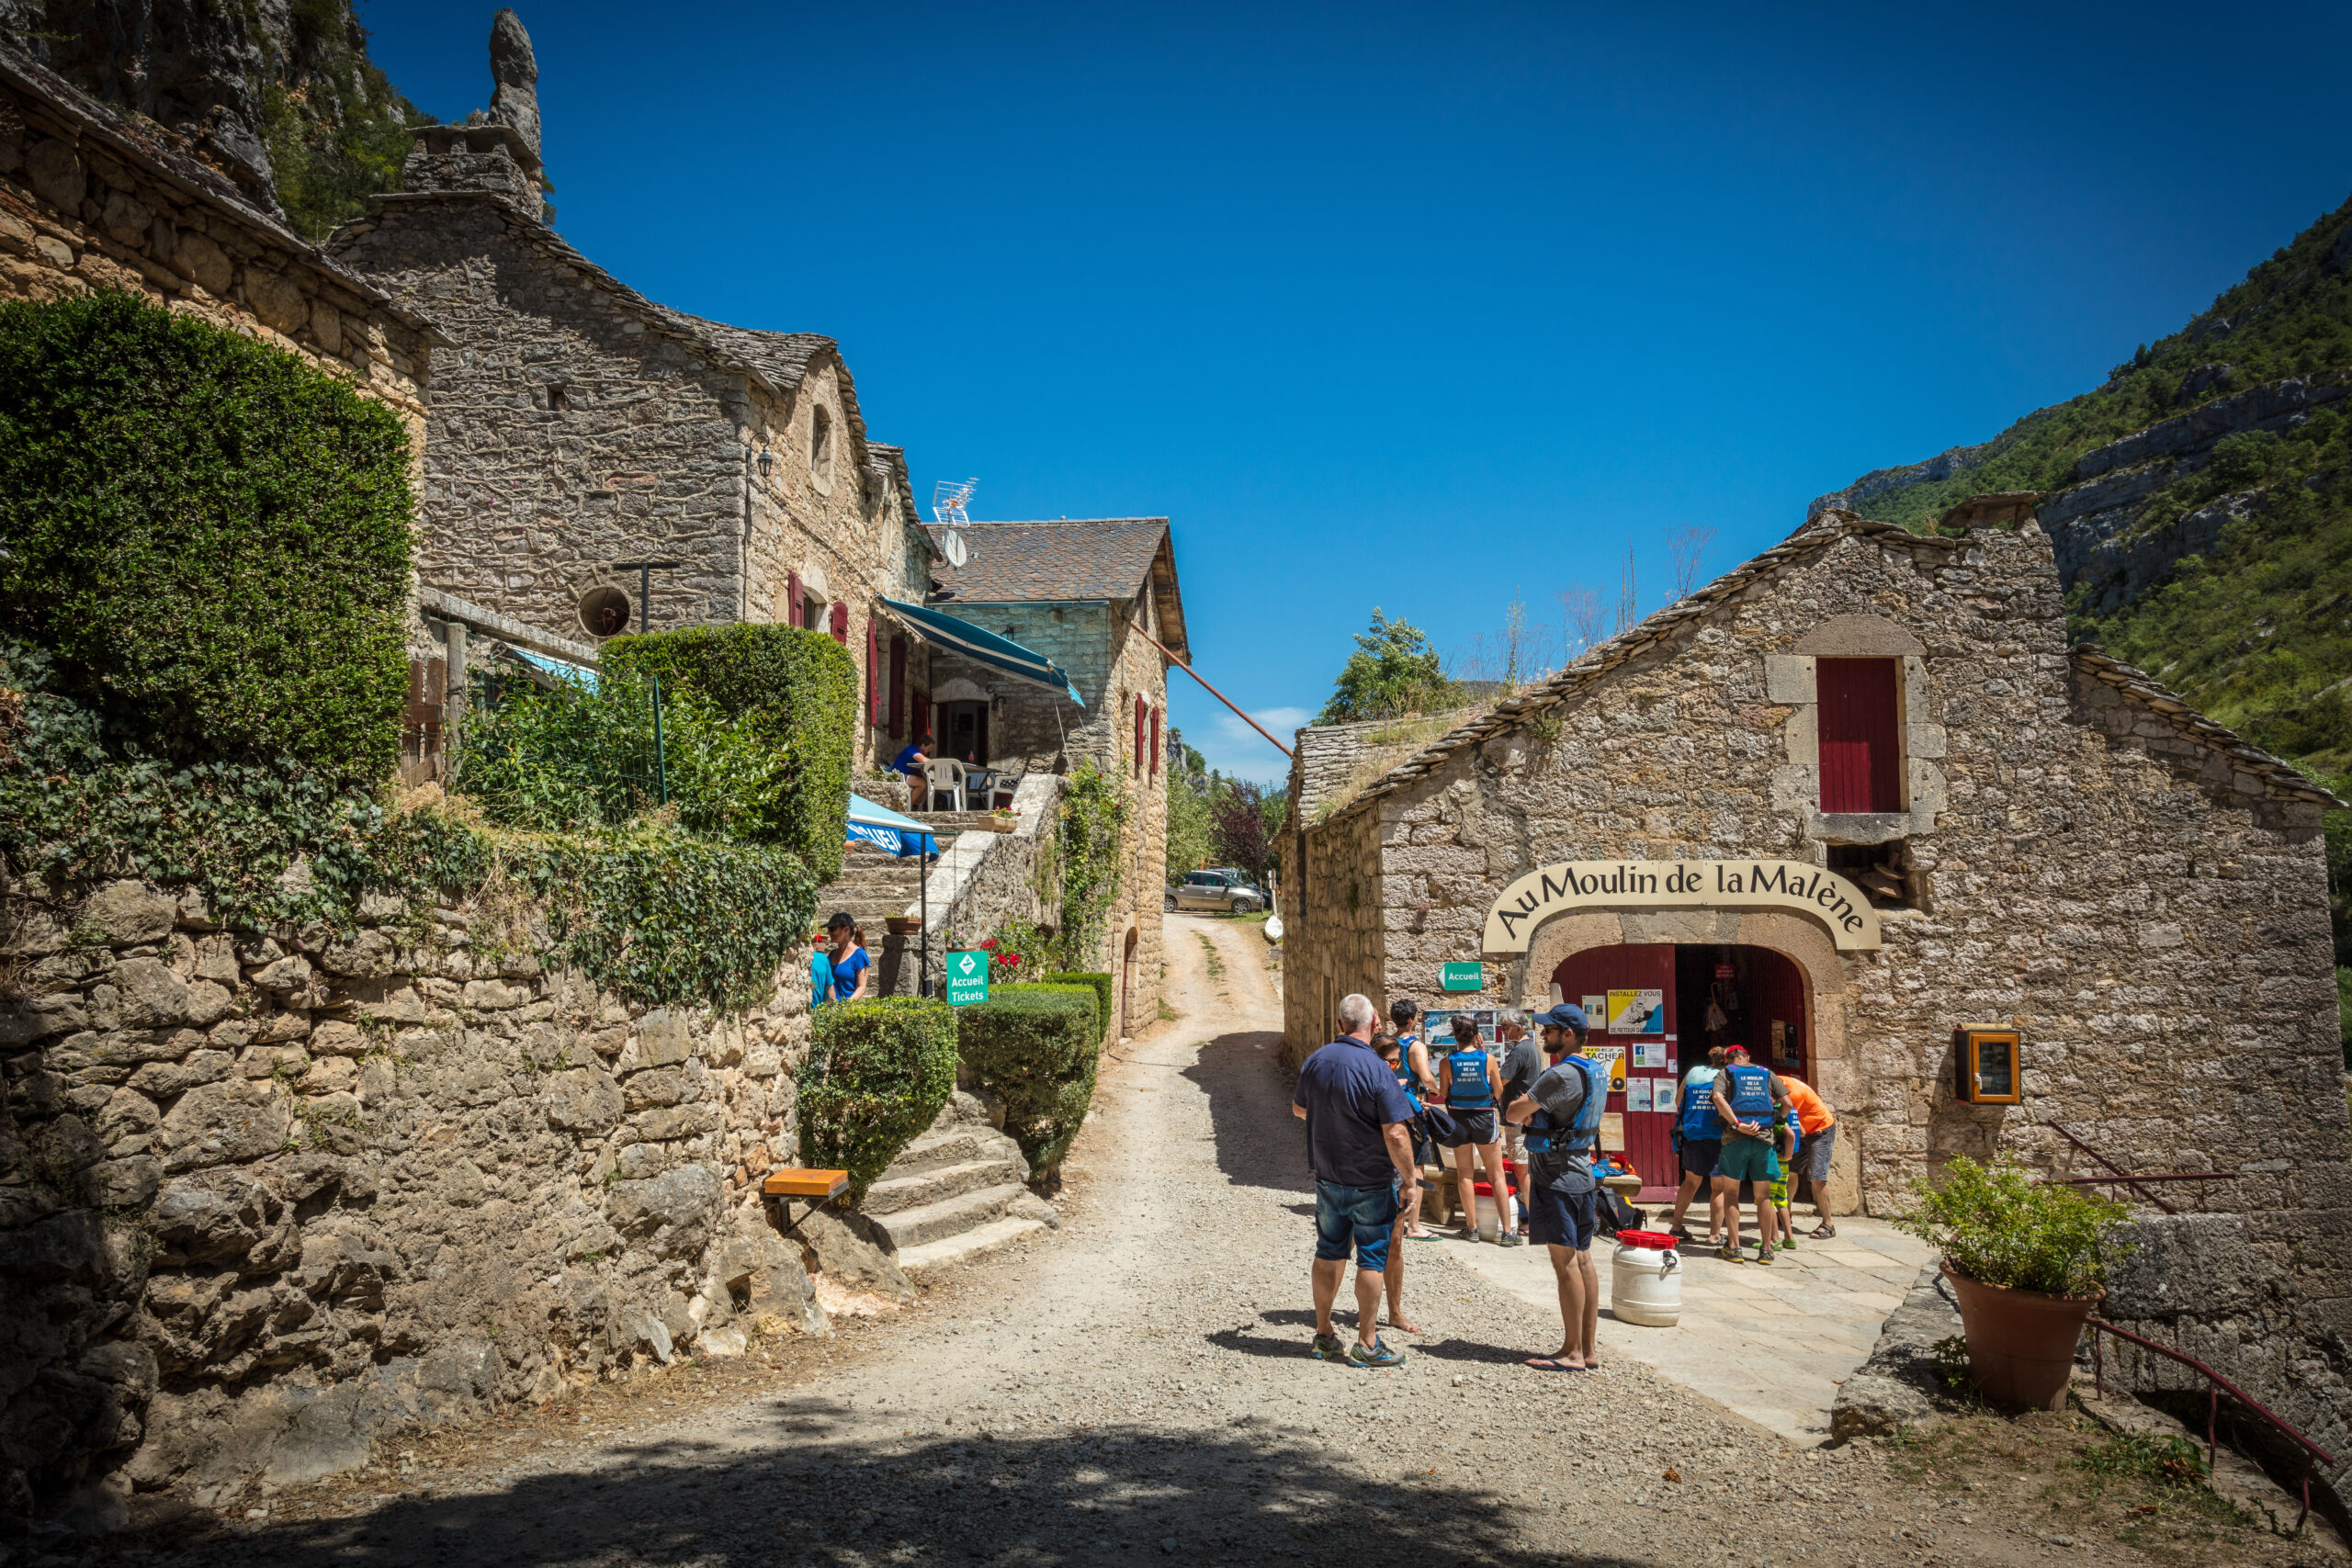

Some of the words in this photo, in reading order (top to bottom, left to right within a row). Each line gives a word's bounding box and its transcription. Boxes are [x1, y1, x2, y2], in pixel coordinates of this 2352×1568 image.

[1498, 889, 1541, 942] Au
[1541, 866, 1657, 903] Moulin
[1666, 864, 1703, 894] de
[1715, 864, 1744, 894] la
[1750, 864, 1863, 934] Malène
[951, 975, 984, 987] Accueil
[1449, 972, 1479, 981] Accueil
[952, 991, 984, 1002] Tickets
[1585, 1052, 1624, 1060] TACHER
